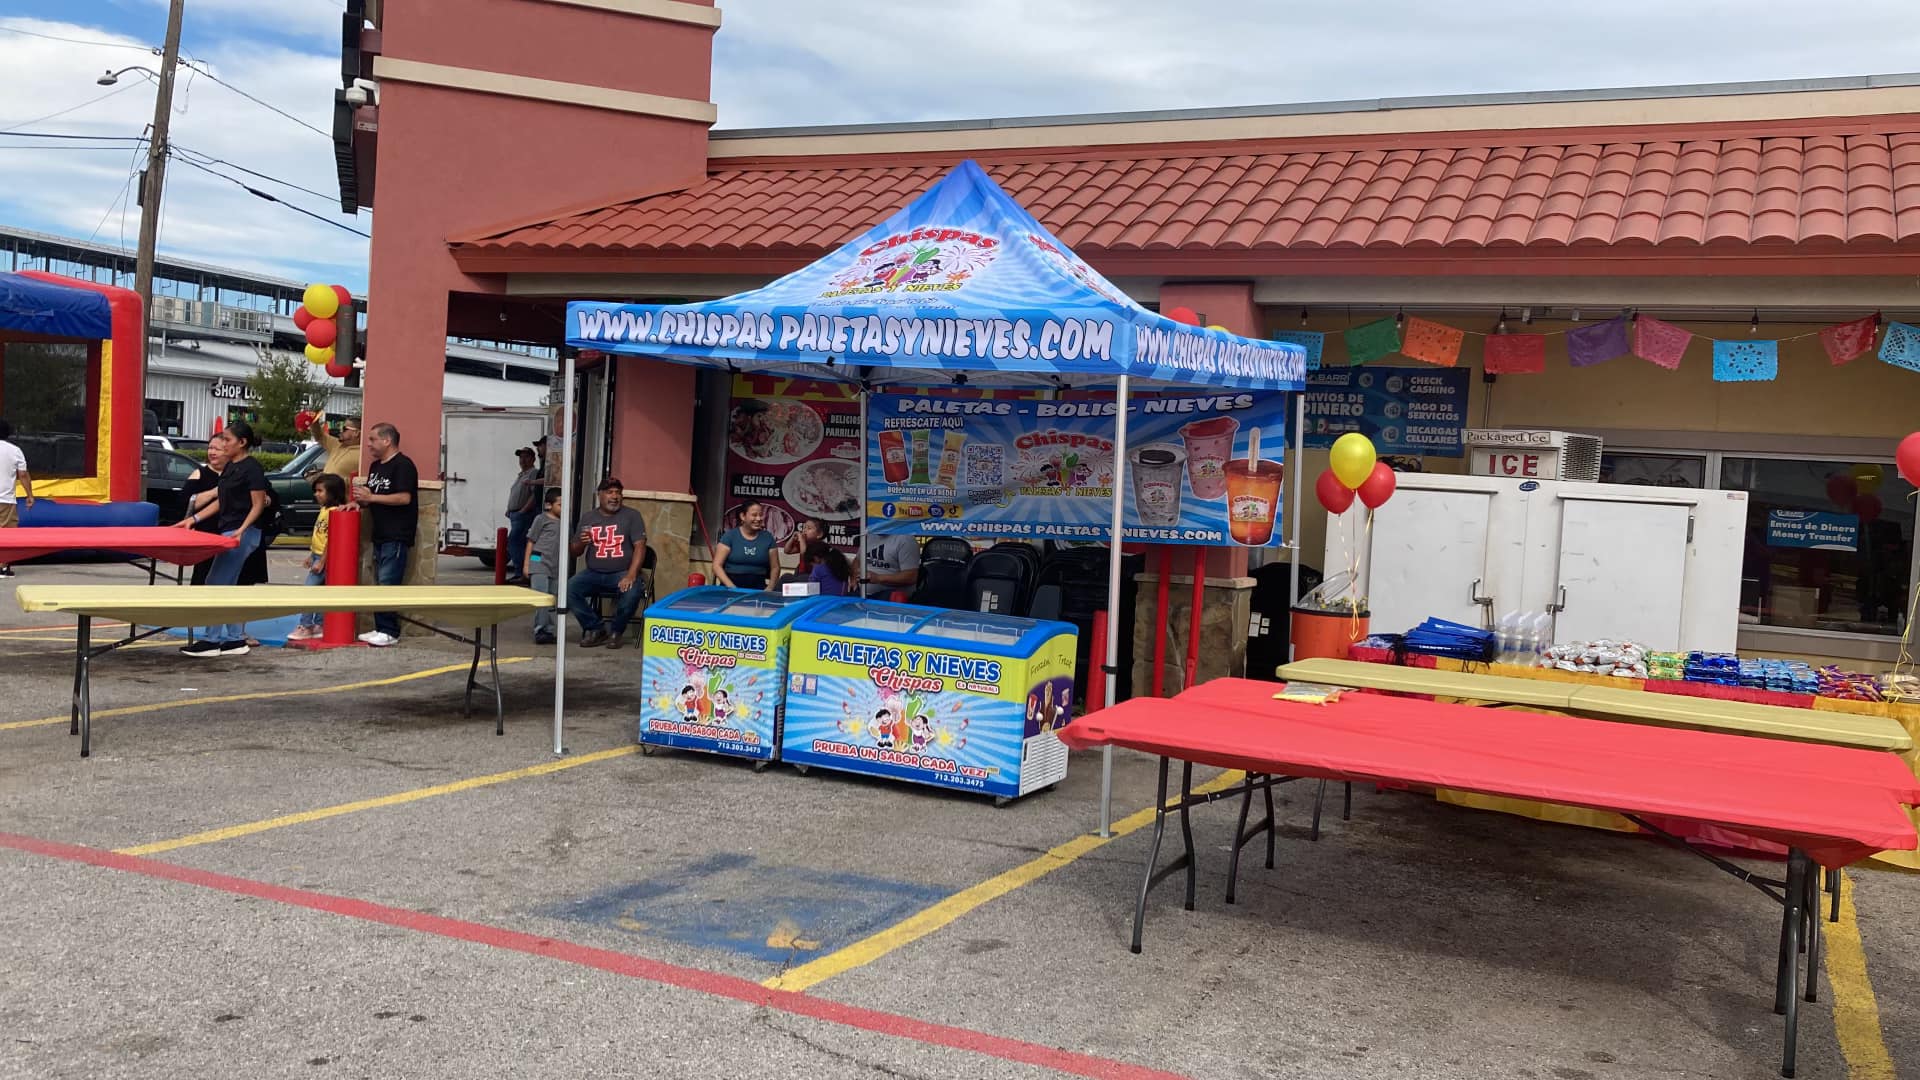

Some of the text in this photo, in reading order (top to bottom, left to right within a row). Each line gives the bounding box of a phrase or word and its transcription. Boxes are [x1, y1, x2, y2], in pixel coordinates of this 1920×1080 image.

[859, 227, 999, 257] Chispas
[578, 310, 1113, 361] WWW.CHISPAS PALETASYNIEVES.COM
[1136, 324, 1306, 382] WWW.CHISPAS PALETASYNIEVES.COM
[1410, 376, 1443, 385] CHECK
[214, 384, 241, 399] SHOP
[1409, 385, 1456, 394] CASHING
[1348, 394, 1364, 403] DE
[898, 398, 1012, 415] PALETAS
[1036, 402, 1118, 417] BOLIS
[1143, 394, 1254, 414] NIEVES
[1408, 403, 1453, 412] PAGO DE
[831, 414, 861, 425] DELICIOS
[1407, 411, 1459, 421] SERVICIOS
[826, 427, 860, 438] PARRILLA
[1406, 426, 1458, 436] RECARGAS
[1467, 431, 1547, 444] Packaged Ice
[1015, 429, 1113, 451] Chispas
[1406, 435, 1458, 444] CELULARES
[1489, 454, 1539, 477] ICE
[742, 475, 775, 485] CHILES
[734, 486, 780, 497] RELLENOS
[1020, 487, 1061, 497] PALETAS
[1075, 486, 1113, 497] NIEVES
[920, 521, 1031, 534] WWW.CHISPAS
[1035, 524, 1101, 536] PALETAS
[1804, 522, 1818, 530] de
[1820, 523, 1856, 533] Dinero
[1772, 530, 1853, 542] Money Transfer
[650, 626, 705, 646] PALETAS
[706, 631, 718, 648] Y
[677, 646, 737, 668] Chispas
[817, 639, 902, 668] PALETAS
[906, 651, 922, 672] Y
[869, 666, 943, 694] Chispas
[650, 720, 678, 733] PRUEBA
[679, 723, 691, 735] UN
[691, 725, 718, 738] SABOR
[718, 728, 741, 741] CADA
[813, 740, 858, 756] PRUEBA
[859, 747, 878, 760] UN
[879, 750, 919, 767] SABOR
[921, 757, 956, 772] CADA
